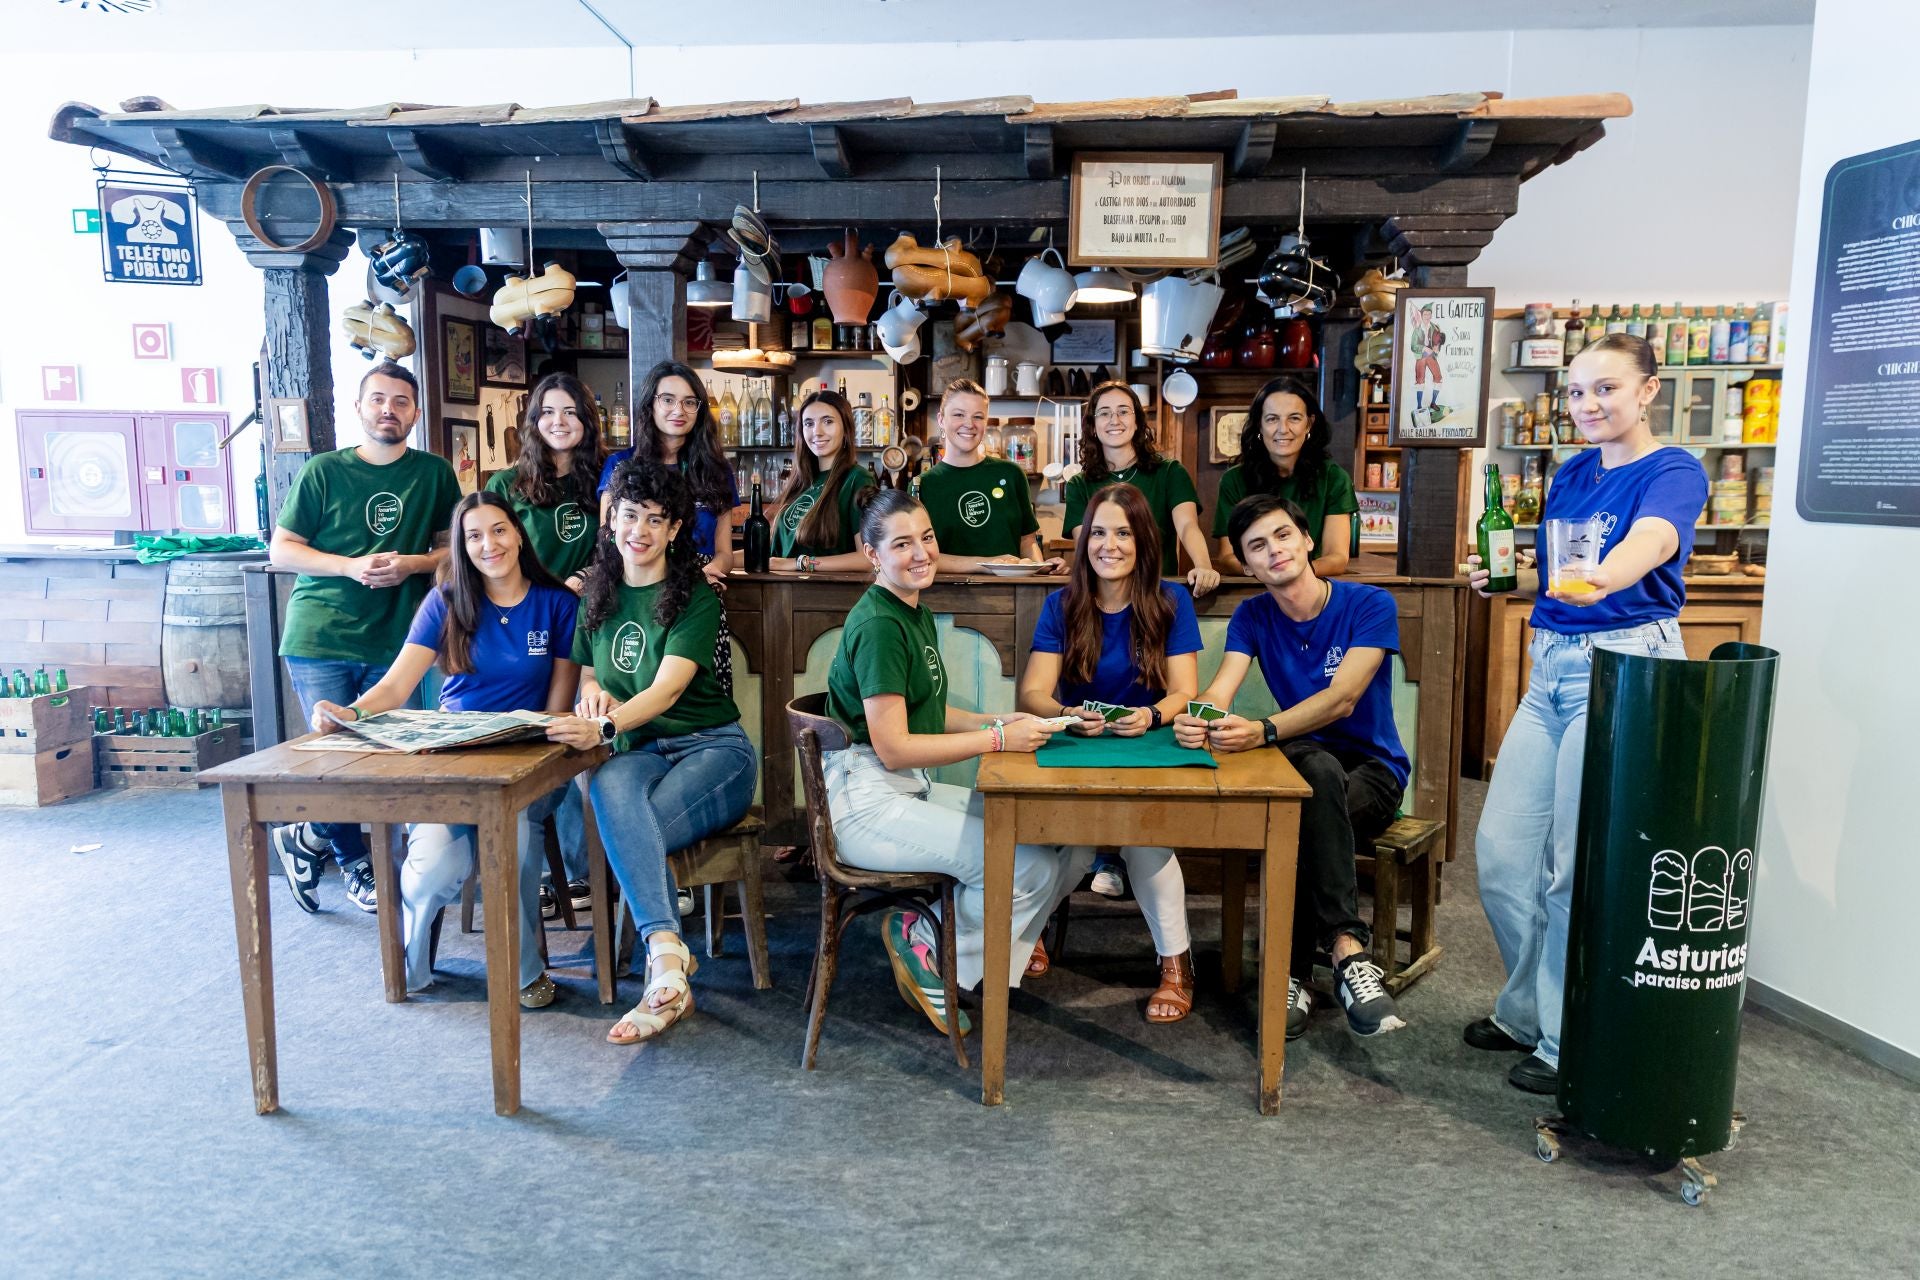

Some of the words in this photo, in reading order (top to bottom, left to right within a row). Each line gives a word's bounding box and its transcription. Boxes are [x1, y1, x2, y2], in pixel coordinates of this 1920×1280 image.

[1100, 196, 1121, 207] CASTIGA
[1123, 196, 1134, 207] POR
[1136, 196, 1149, 207] DIOS
[1160, 196, 1196, 208] AUTORIDADES
[1103, 214, 1134, 225] BLASFEMAR
[1139, 214, 1161, 225] ESCUPIR
[1171, 215, 1187, 225] SUELO
[1111, 233, 1124, 243] BAJO
[1126, 233, 1132, 242] LA
[1134, 233, 1152, 243] MULTA
[116, 244, 191, 263] TELÉFONO
[1435, 303, 1444, 318] EL
[1448, 299, 1485, 318] GAITERO
[1635, 936, 1748, 973] Asturias
[1635, 970, 1701, 991] paraíso
